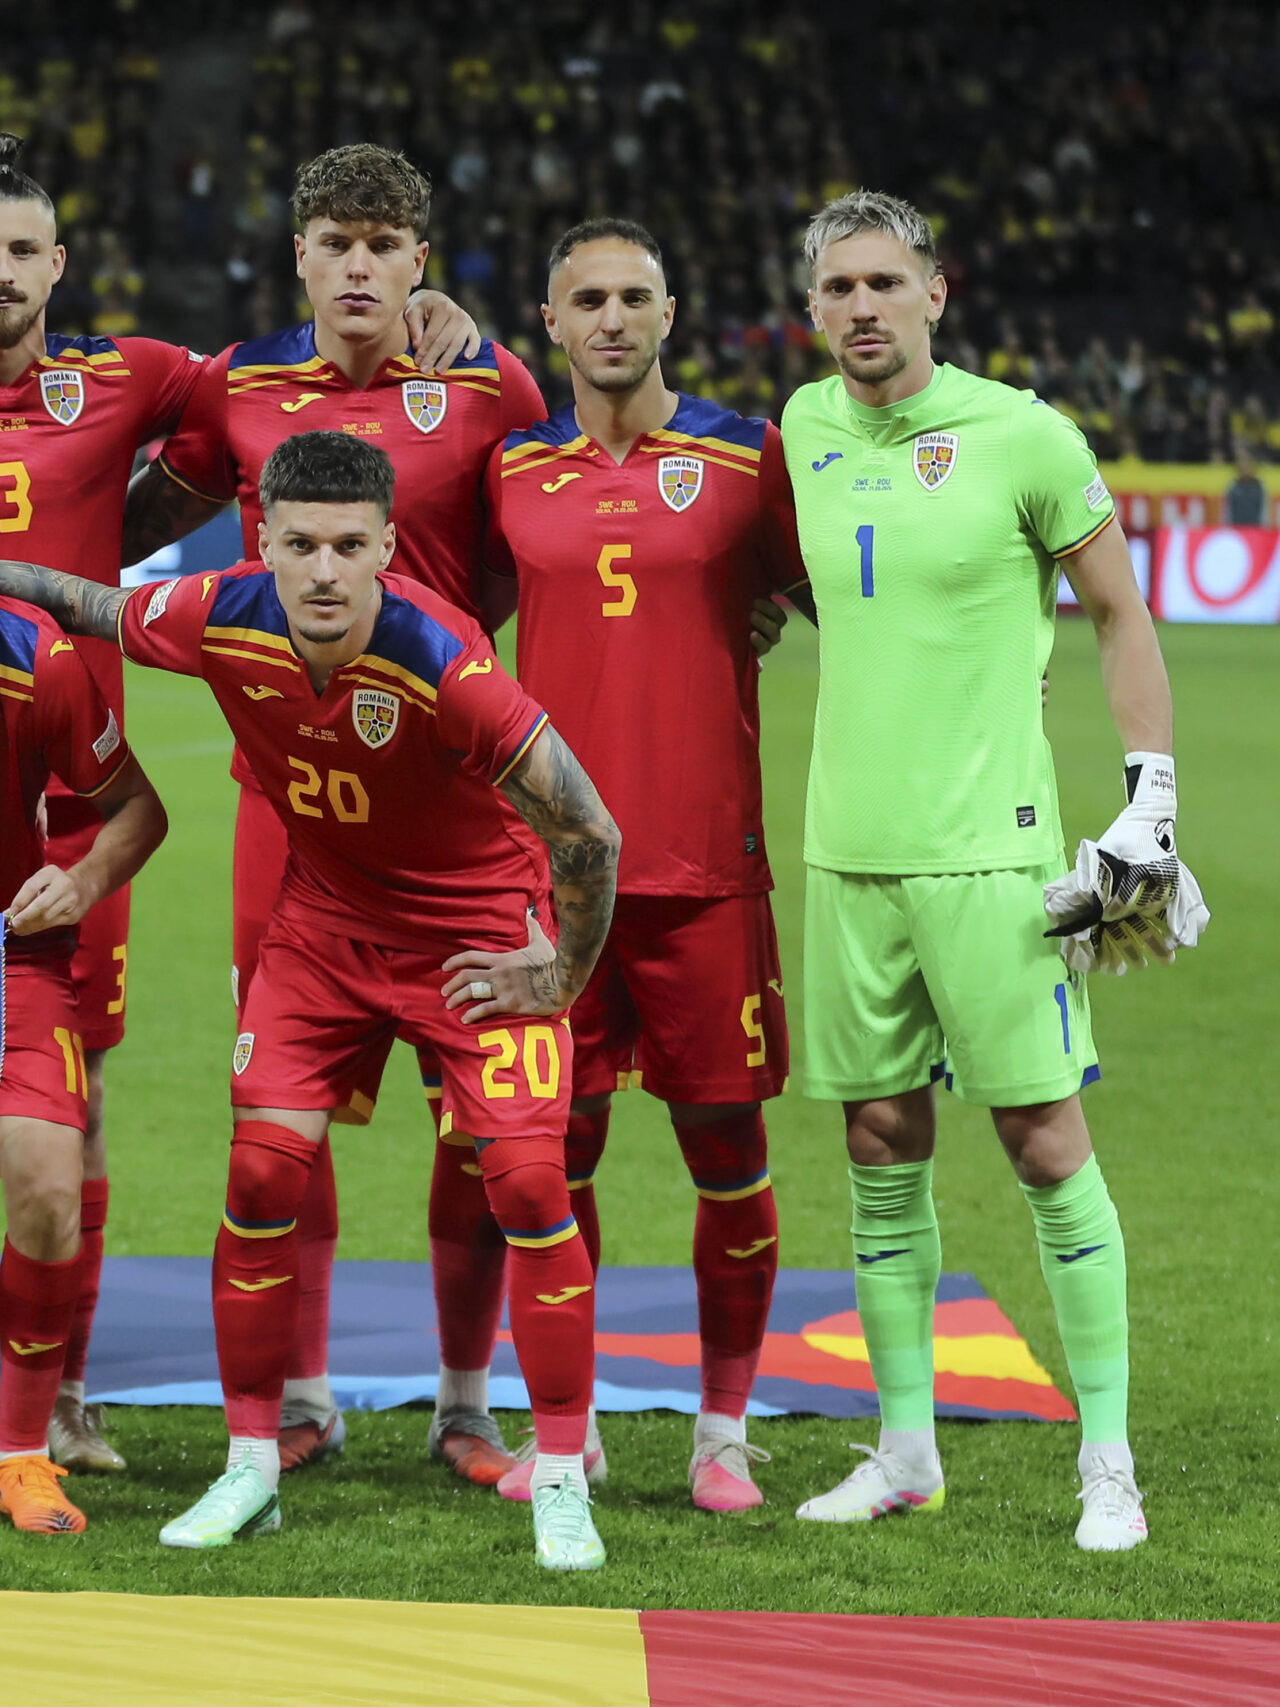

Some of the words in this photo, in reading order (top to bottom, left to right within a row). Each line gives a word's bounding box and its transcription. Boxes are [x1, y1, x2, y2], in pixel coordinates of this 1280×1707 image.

[43, 372, 78, 384] ROMÂNIA
[406, 381, 442, 393] ROMÂNIA
[662, 458, 699, 470] ROMÂNIA
[918, 433, 954, 446] ROMÂNIA
[596, 544, 638, 617] 5
[855, 525, 874, 597] 1
[358, 693, 395, 707] ROMÂNIA
[287, 755, 370, 823] 20
[740, 993, 766, 1068] 5
[1054, 983, 1070, 1055] 1
[53, 1026, 88, 1102] 11
[478, 1025, 560, 1099] 20
